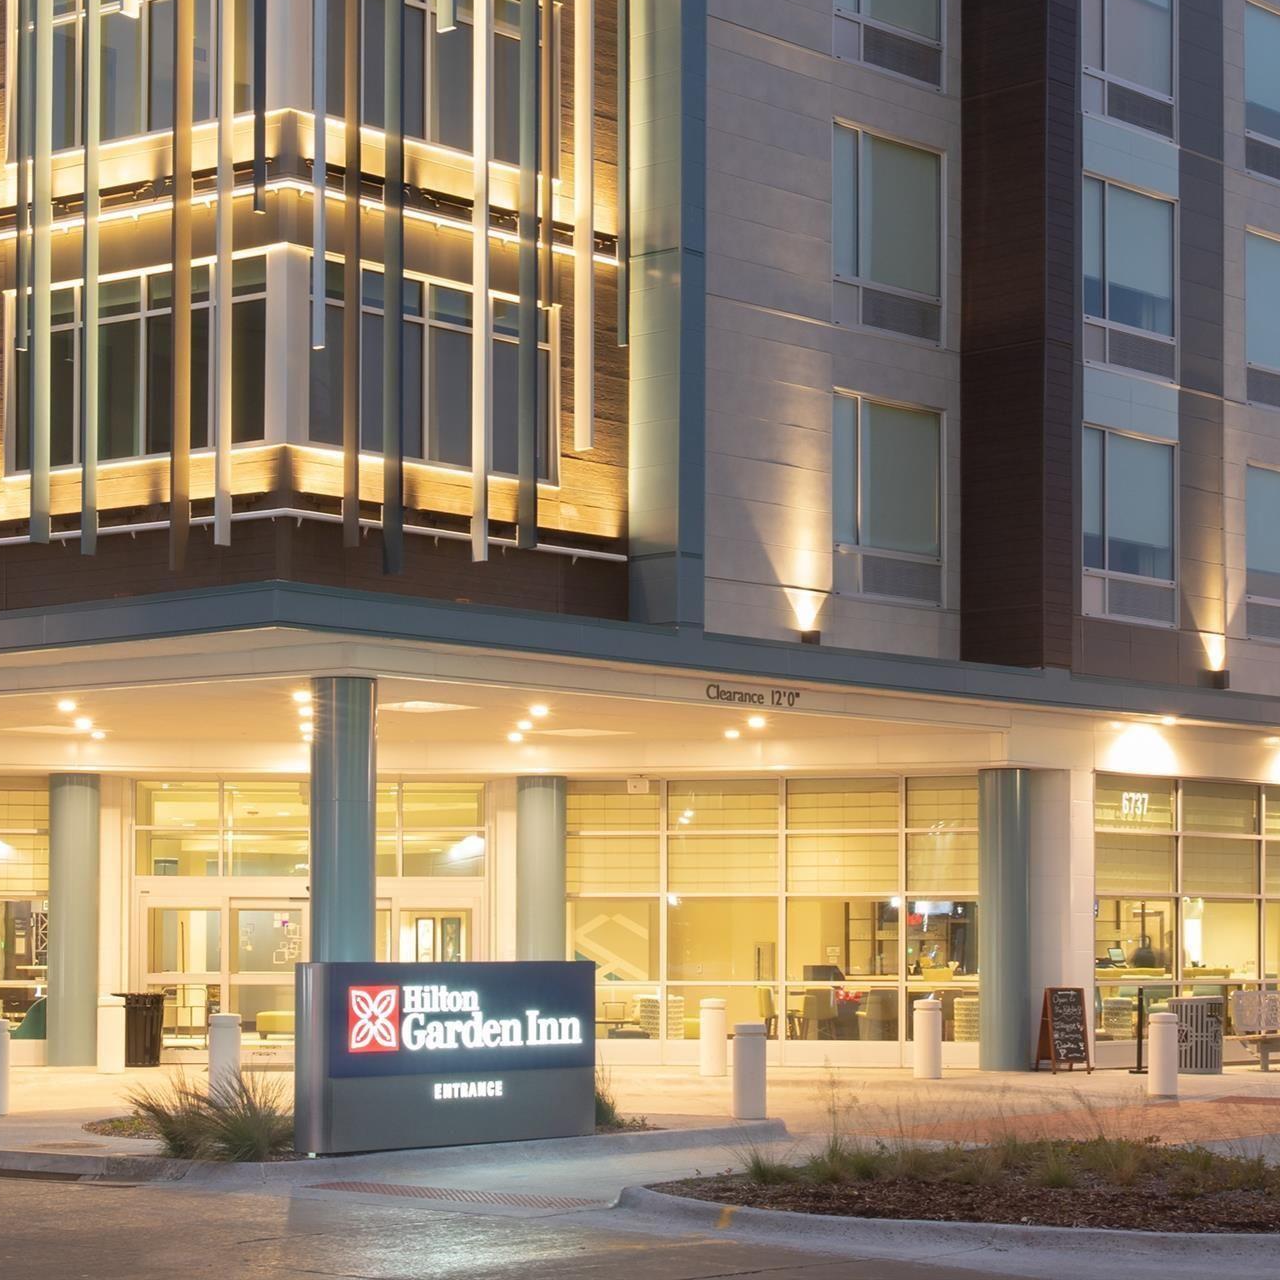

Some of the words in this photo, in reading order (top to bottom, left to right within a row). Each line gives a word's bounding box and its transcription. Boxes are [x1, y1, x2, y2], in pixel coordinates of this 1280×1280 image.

[706, 684, 764, 704] Clearance
[1122, 791, 1149, 816] 6737
[403, 985, 480, 1013] Hilton
[402, 1010, 524, 1051] Garden
[525, 1009, 582, 1046] Inn
[434, 1080, 503, 1100] ENTRANCE
